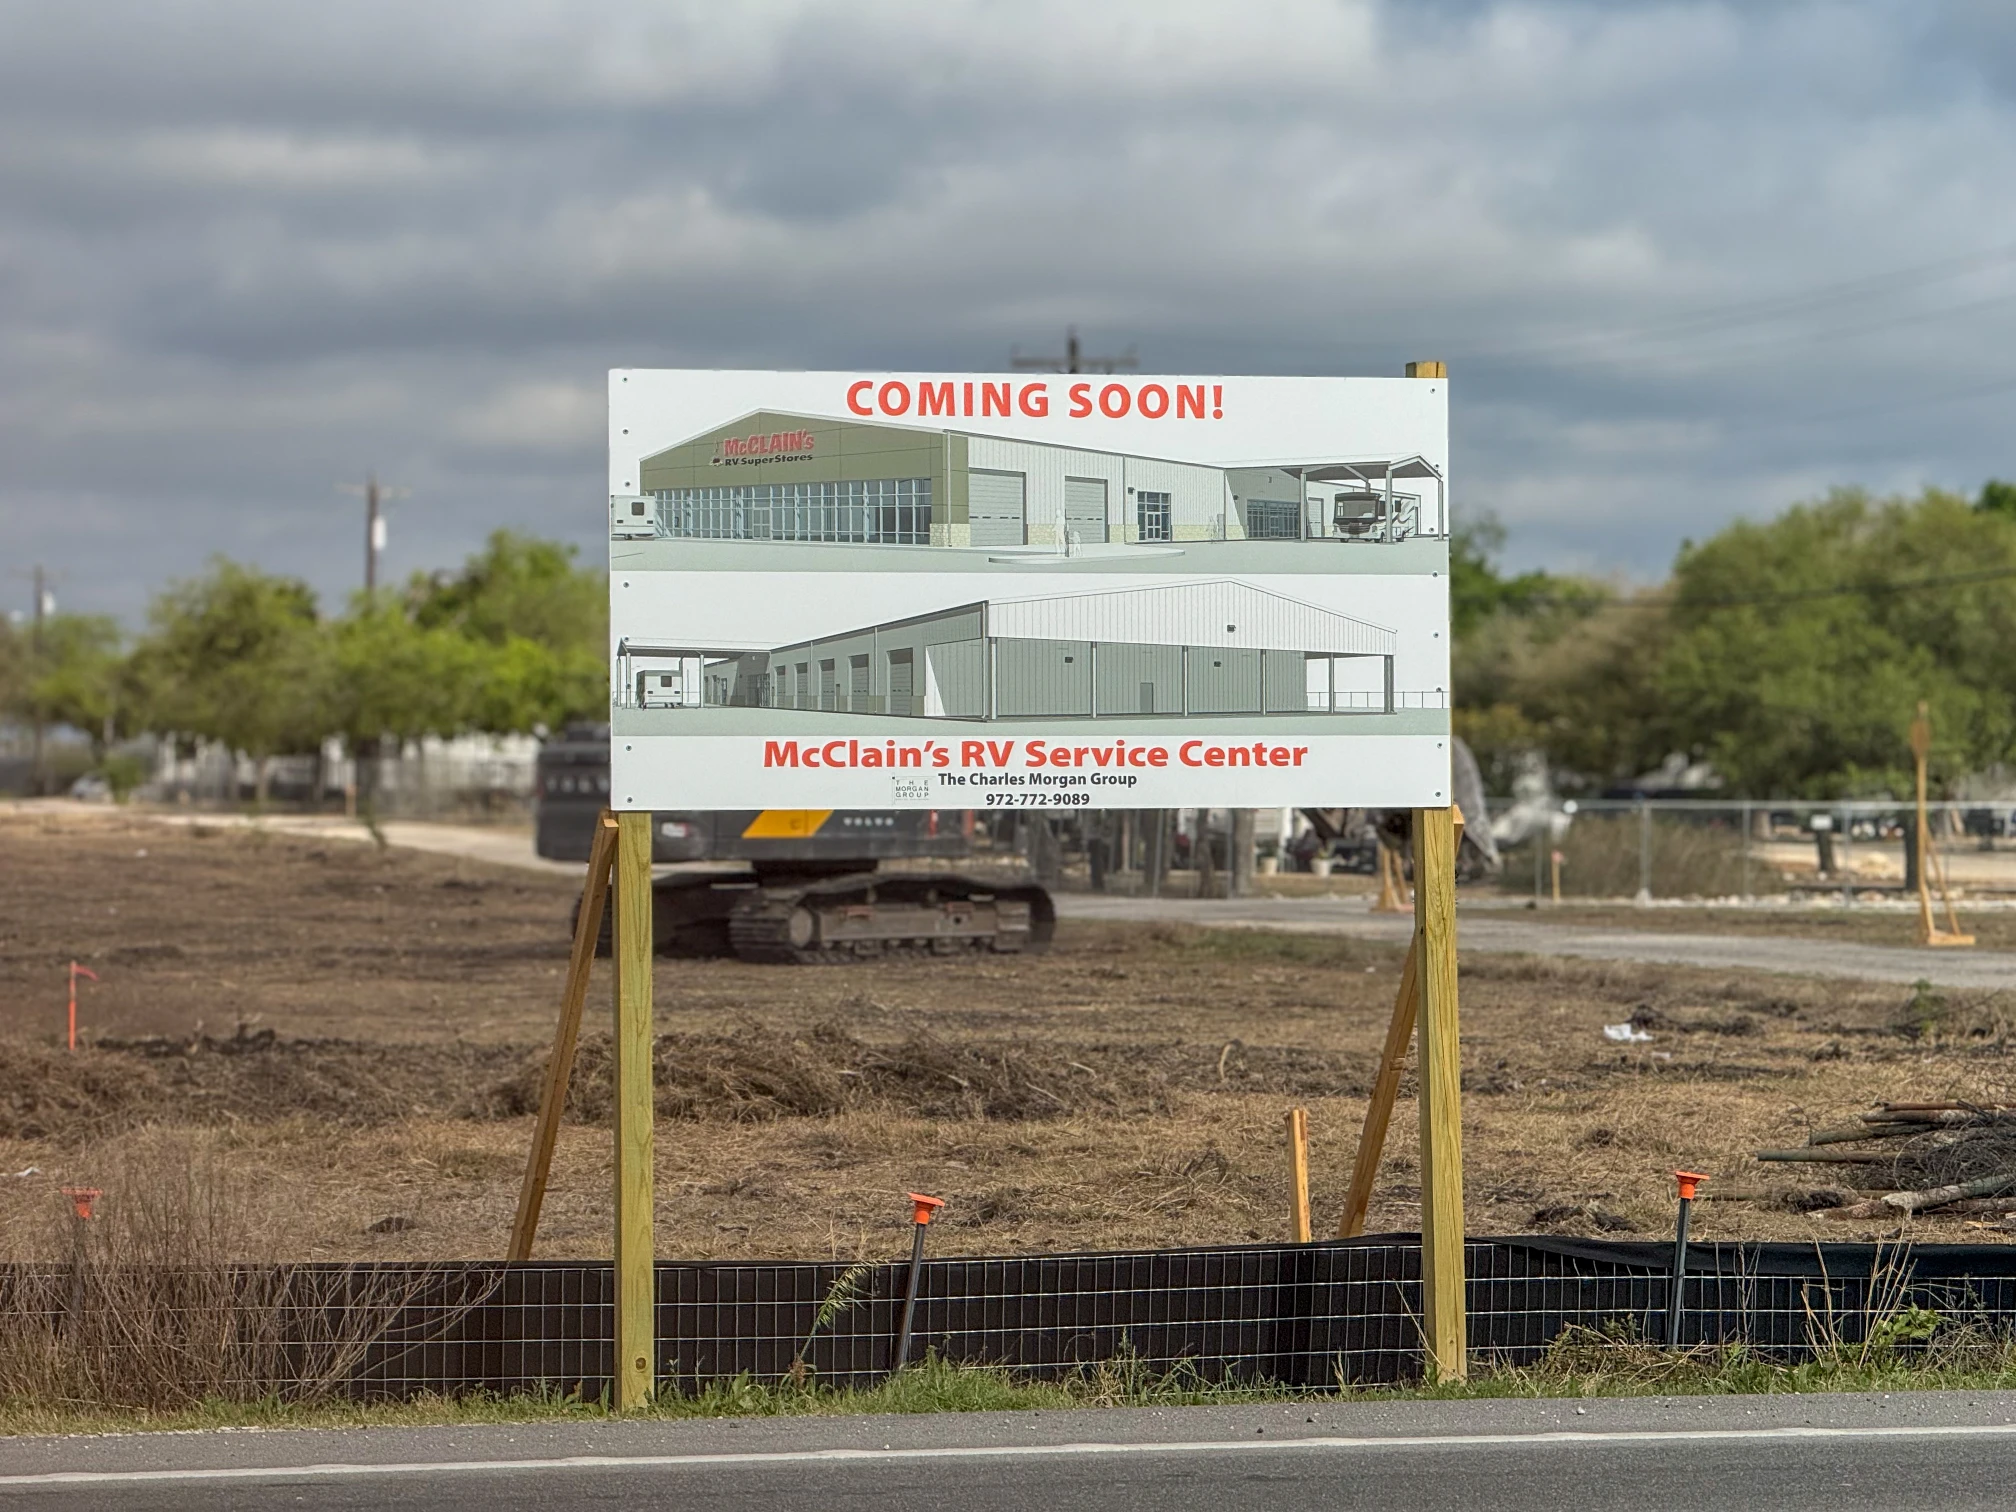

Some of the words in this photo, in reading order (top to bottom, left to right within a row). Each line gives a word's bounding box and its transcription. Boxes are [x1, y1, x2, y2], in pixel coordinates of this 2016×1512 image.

[846, 380, 1049, 418] COMING
[1068, 382, 1224, 420] SOON!
[724, 429, 815, 456] McCLAIN's
[725, 457, 739, 467] RV
[741, 454, 813, 467] SuperStores
[763, 739, 950, 768] McClain's
[961, 740, 1015, 768] RV
[1025, 739, 1169, 768] Service
[1178, 739, 1309, 768] Center
[937, 772, 966, 786] The
[969, 772, 1026, 786] Charles
[1028, 772, 1087, 789] Morgan
[1090, 772, 1138, 789] Group
[985, 793, 1090, 806] 972-772-9089
